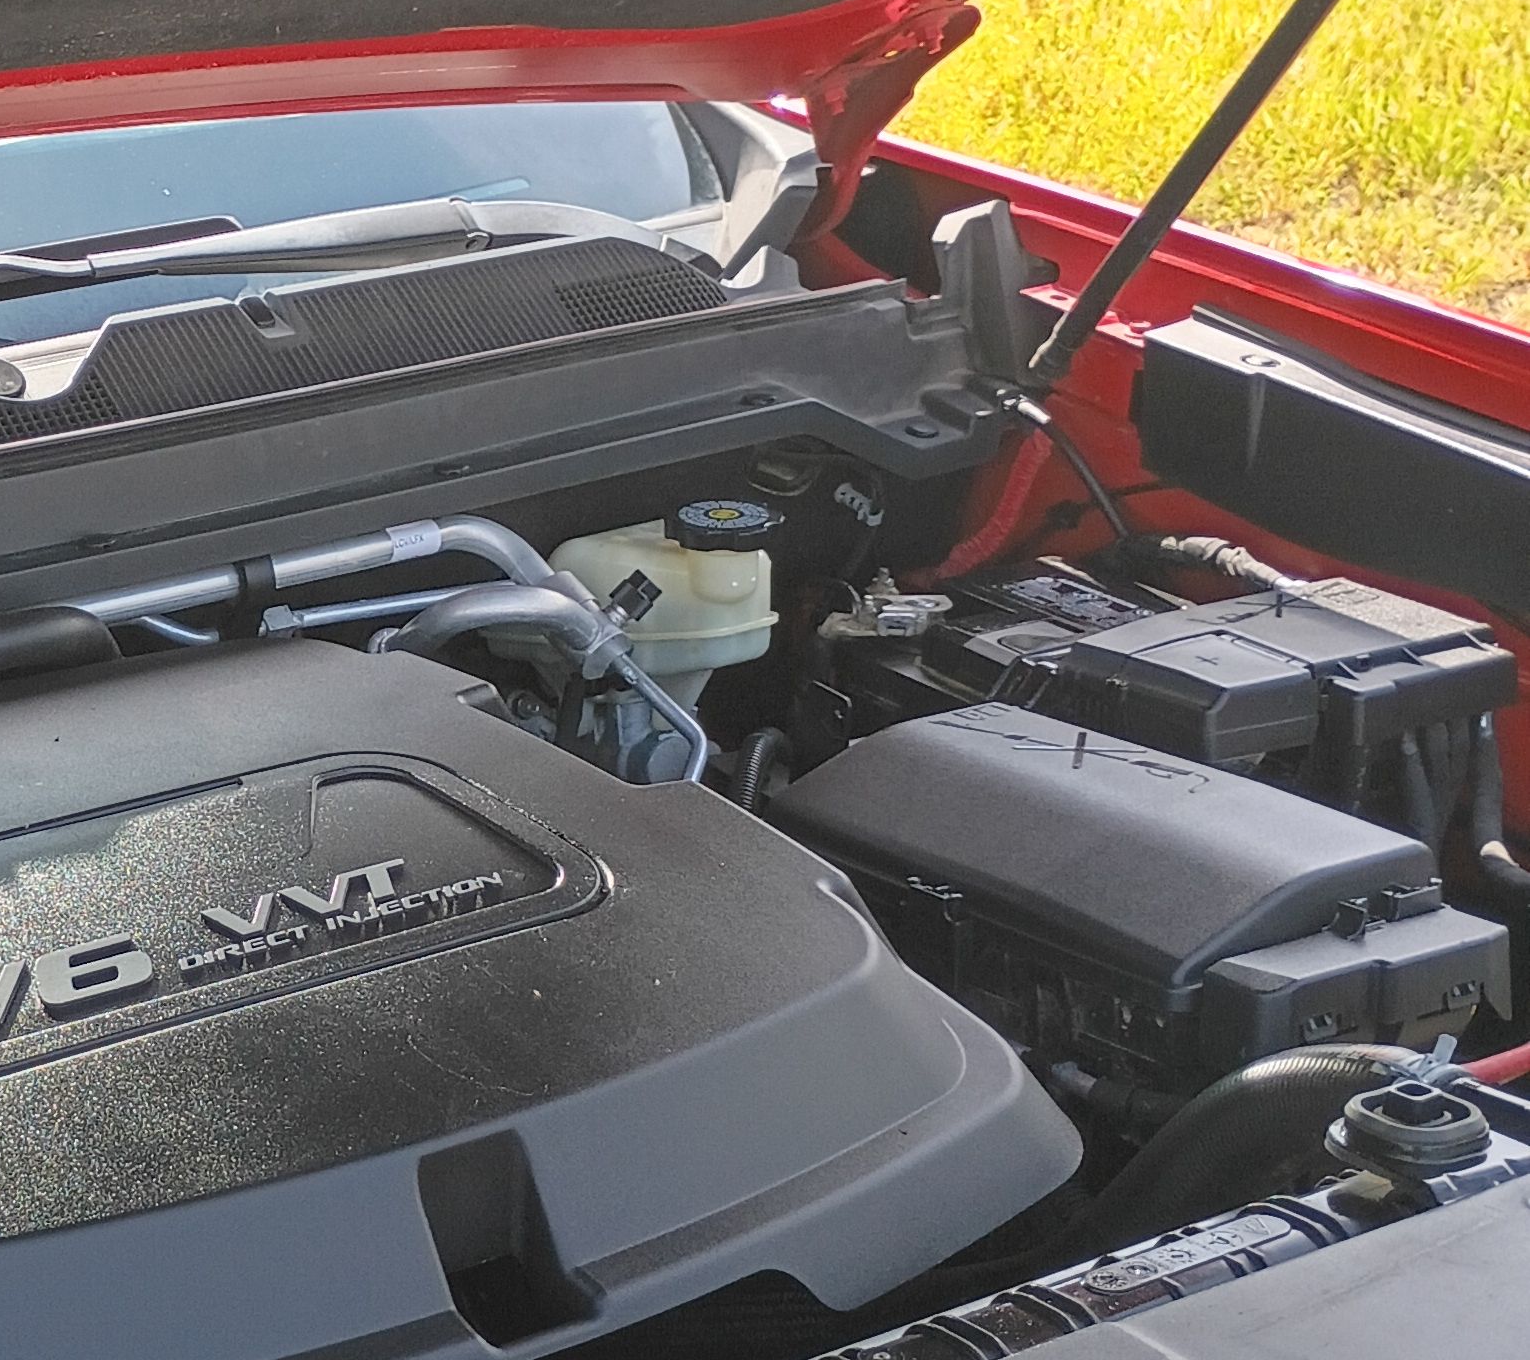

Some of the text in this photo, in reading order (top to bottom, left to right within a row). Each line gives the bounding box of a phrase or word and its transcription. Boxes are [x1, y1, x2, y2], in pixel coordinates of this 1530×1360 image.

[177, 871, 504, 971] DIRECT INJECTION
[199, 858, 405, 938] VVT
